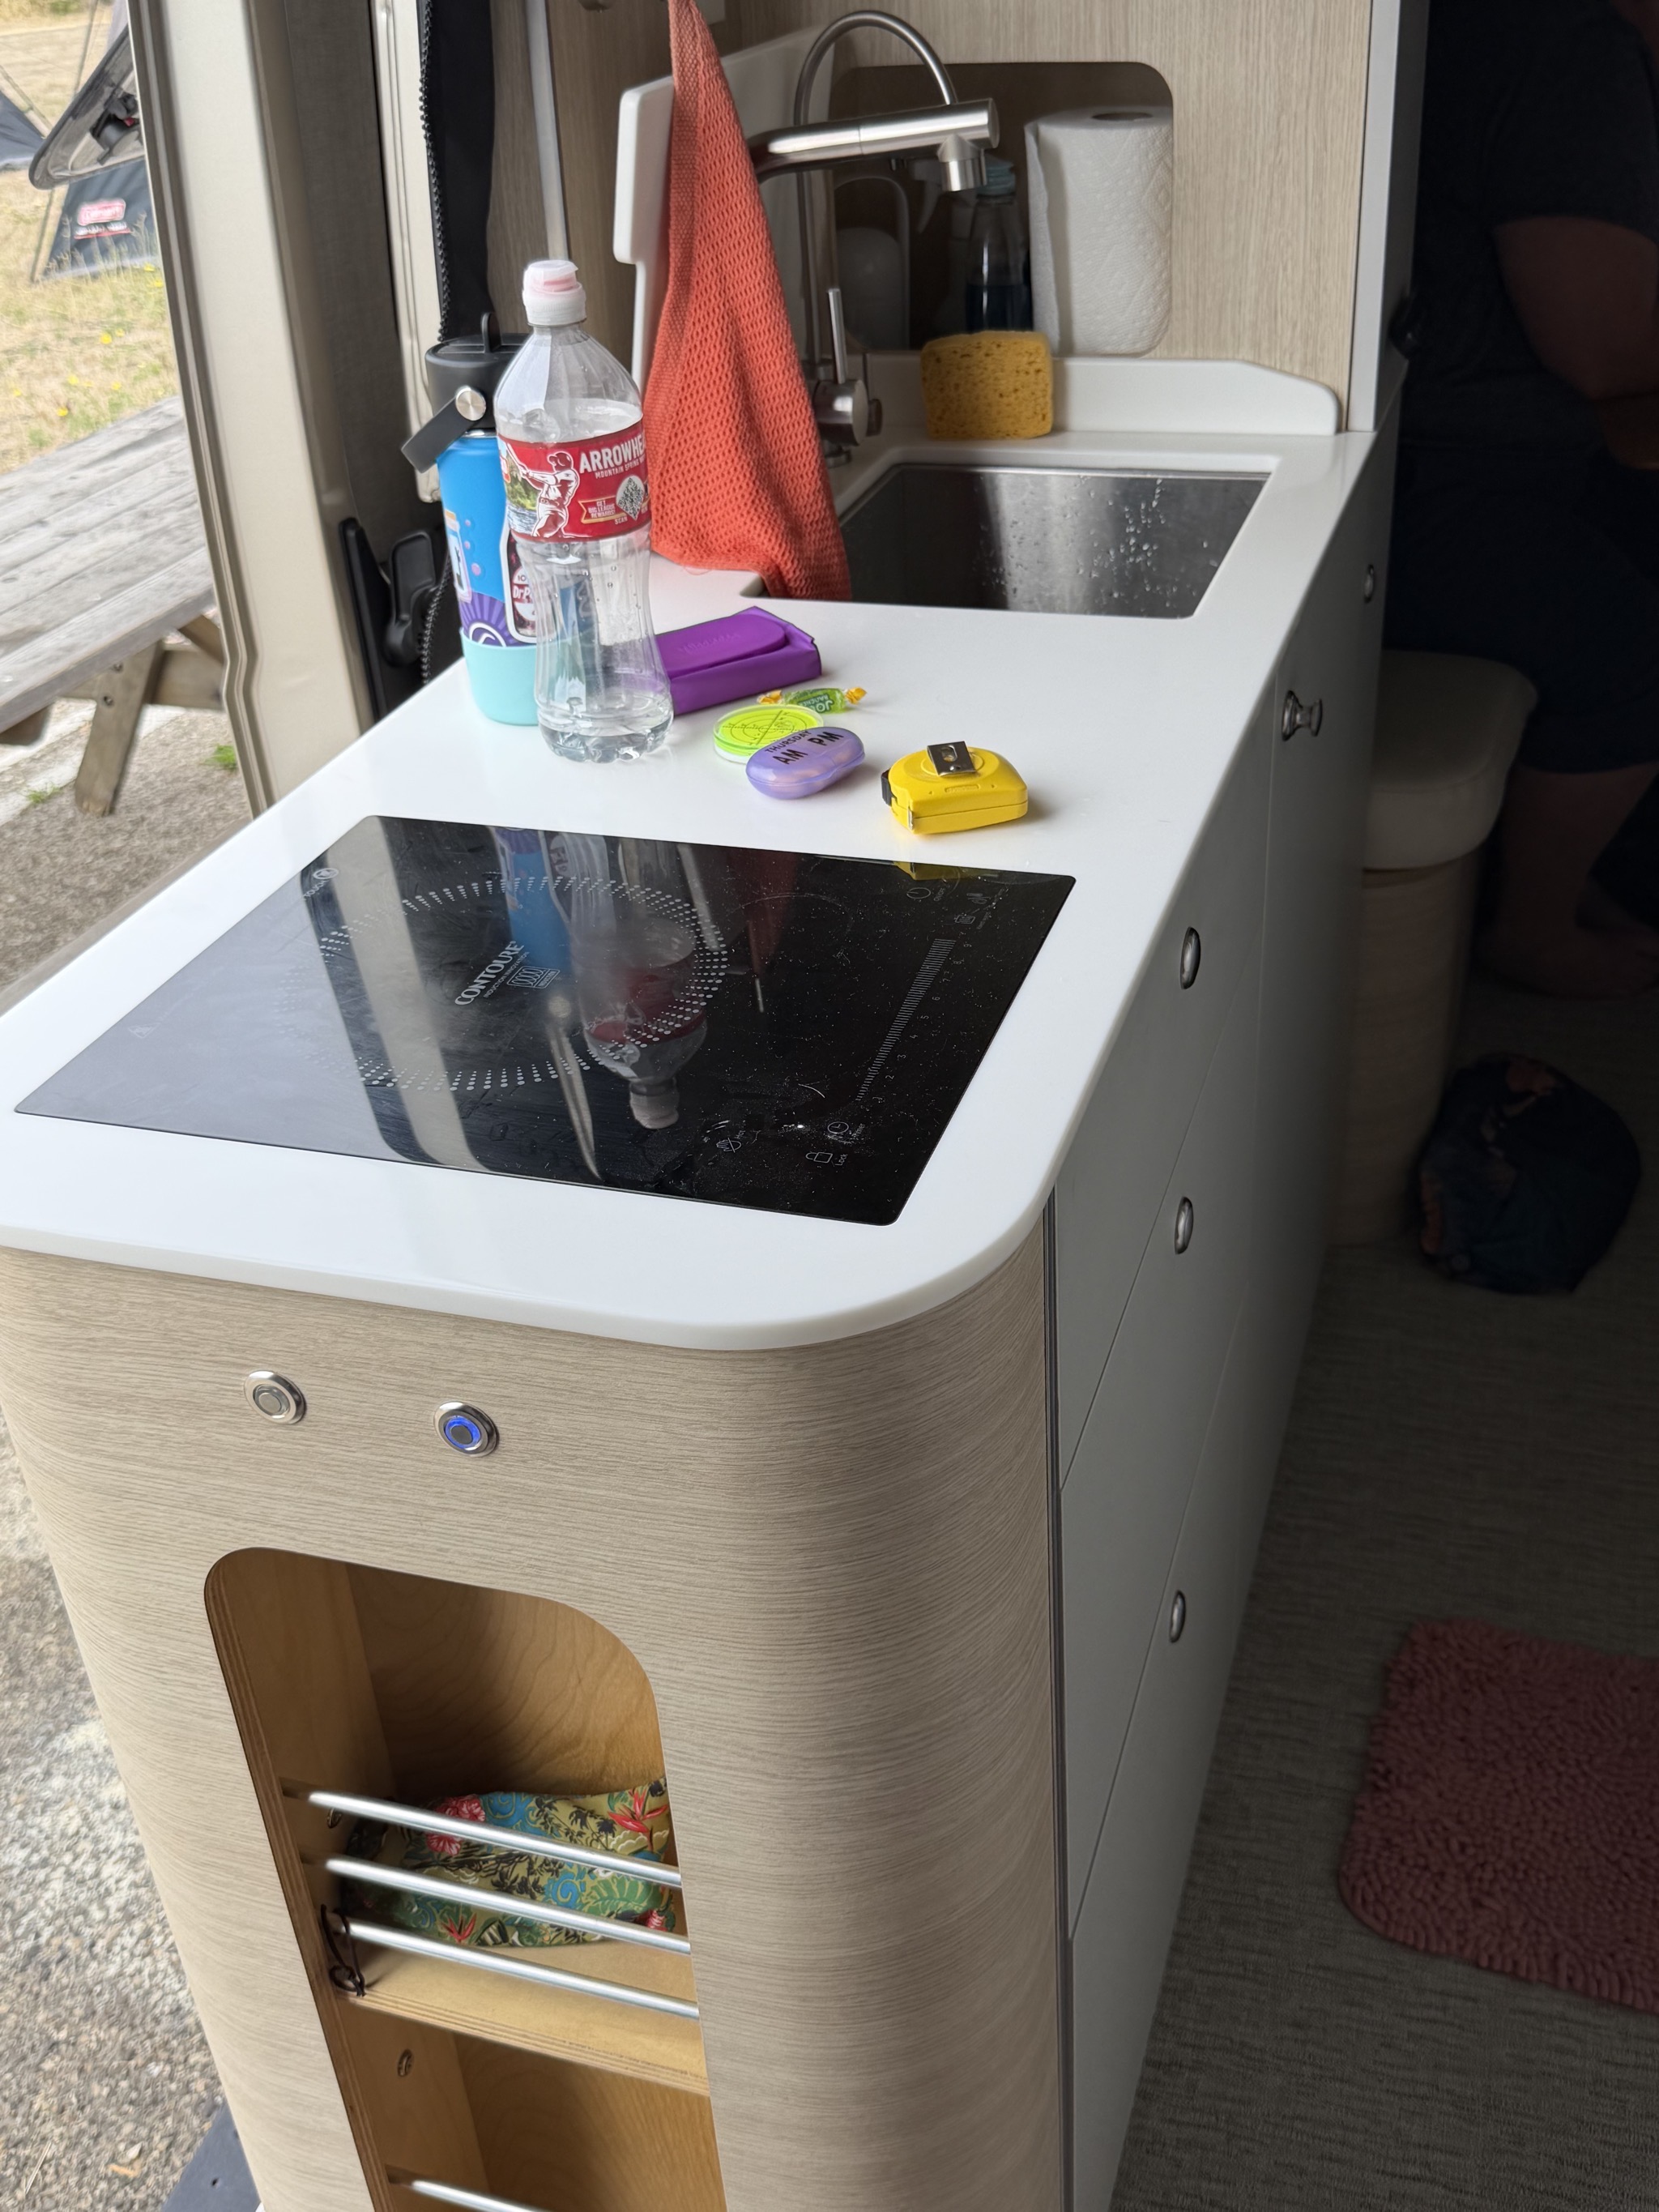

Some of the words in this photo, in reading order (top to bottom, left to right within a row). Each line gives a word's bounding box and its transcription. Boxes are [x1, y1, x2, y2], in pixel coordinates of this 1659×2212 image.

[595, 466, 624, 479] MOUNTAIN
[625, 459, 639, 471] SPRING
[598, 503, 616, 512] LEAGUE
[615, 516, 628, 524] SCAN
[765, 729, 812, 754] THURSDAY
[773, 749, 808, 765] AM
[808, 732, 844, 746] PM
[483, 975, 507, 997] INDUCTION
[504, 951, 530, 976] INNOVATION
[834, 1153, 849, 1166] Lock
